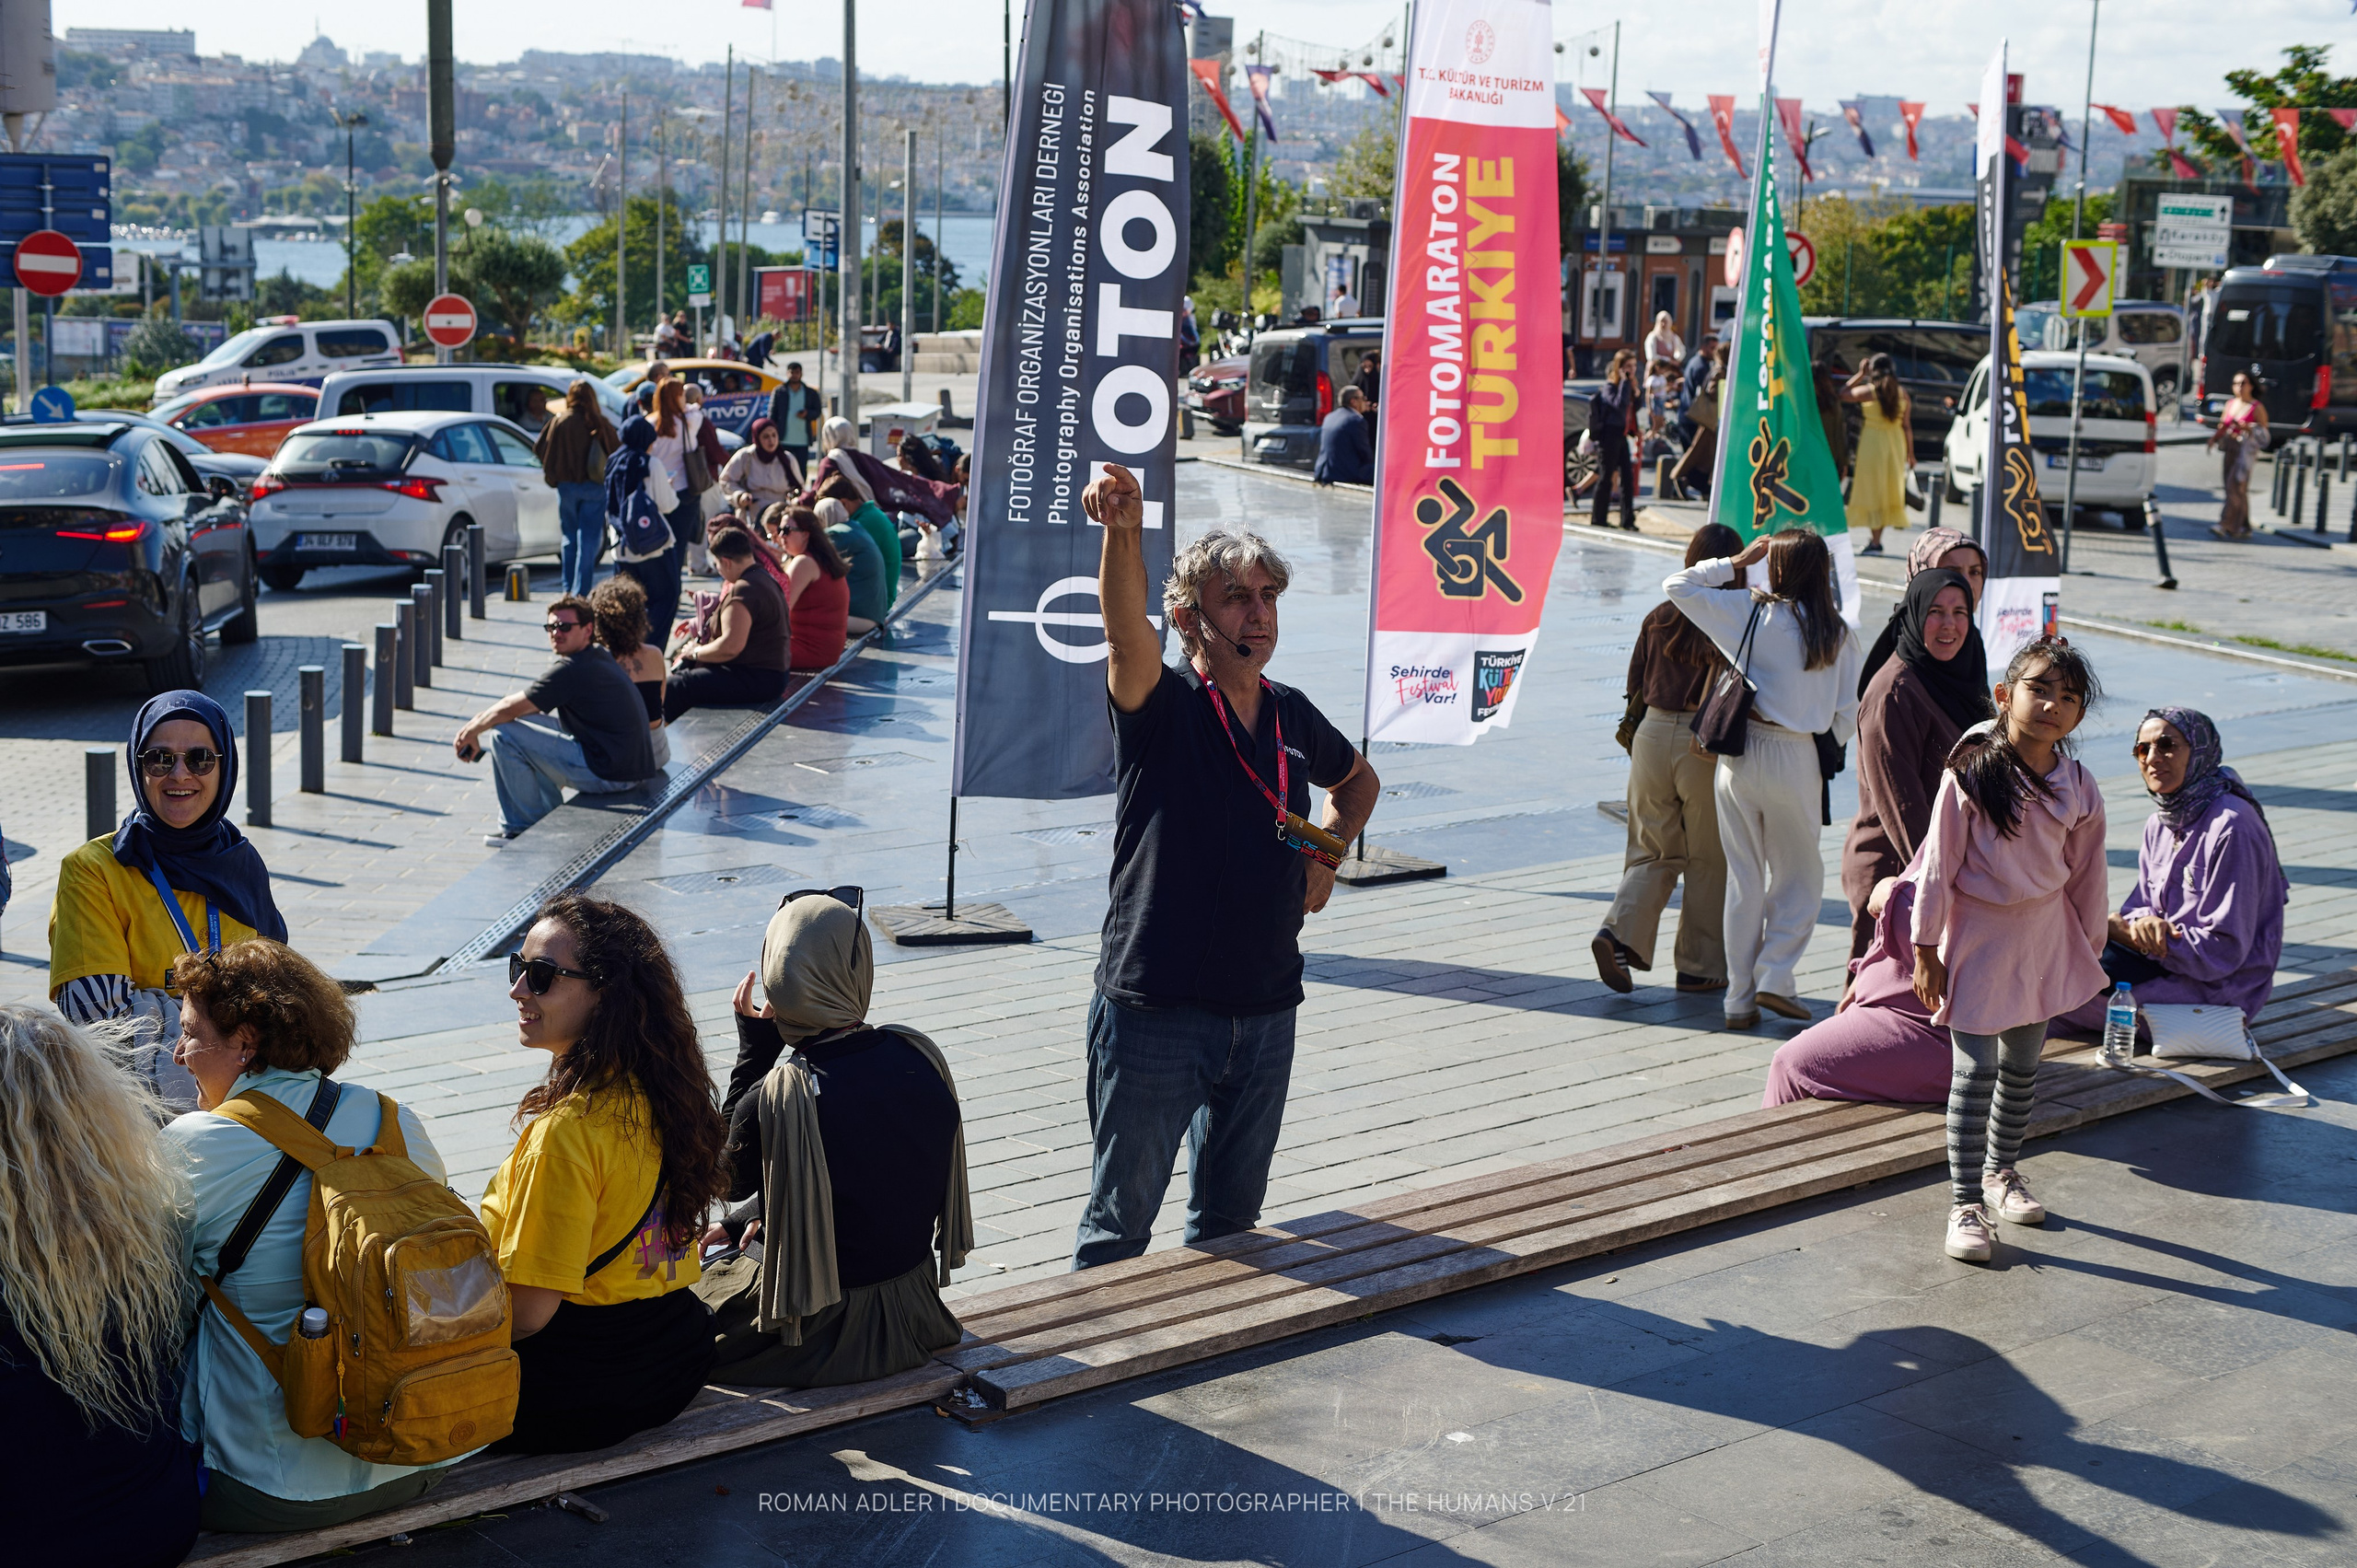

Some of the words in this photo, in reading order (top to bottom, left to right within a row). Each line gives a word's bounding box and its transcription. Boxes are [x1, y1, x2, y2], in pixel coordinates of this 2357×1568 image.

[1438, 68, 1476, 85] KÜLTÜR
[1479, 75, 1491, 87] VE
[1494, 76, 1544, 91] TURİZM
[1449, 87, 1504, 105] BAKANLIĞI
[1036, 82, 1066, 180] DERNEĞİ
[1072, 89, 1096, 219] Association
[1016, 185, 1057, 405] ORGANİZASYONLARI
[1059, 225, 1087, 378] Organisations
[1425, 152, 1463, 468] FOTOMARATON
[1464, 157, 1519, 470] TÜRKİYE
[1007, 408, 1038, 523] FOTOĞRAF
[1048, 385, 1081, 525] Photography
[16, 613, 41, 629] 586
[1480, 654, 1524, 668] TÜRKİYE
[1390, 665, 1450, 679] Şehirde
[1396, 669, 1459, 705] Festival
[1424, 692, 1457, 704] Var!
